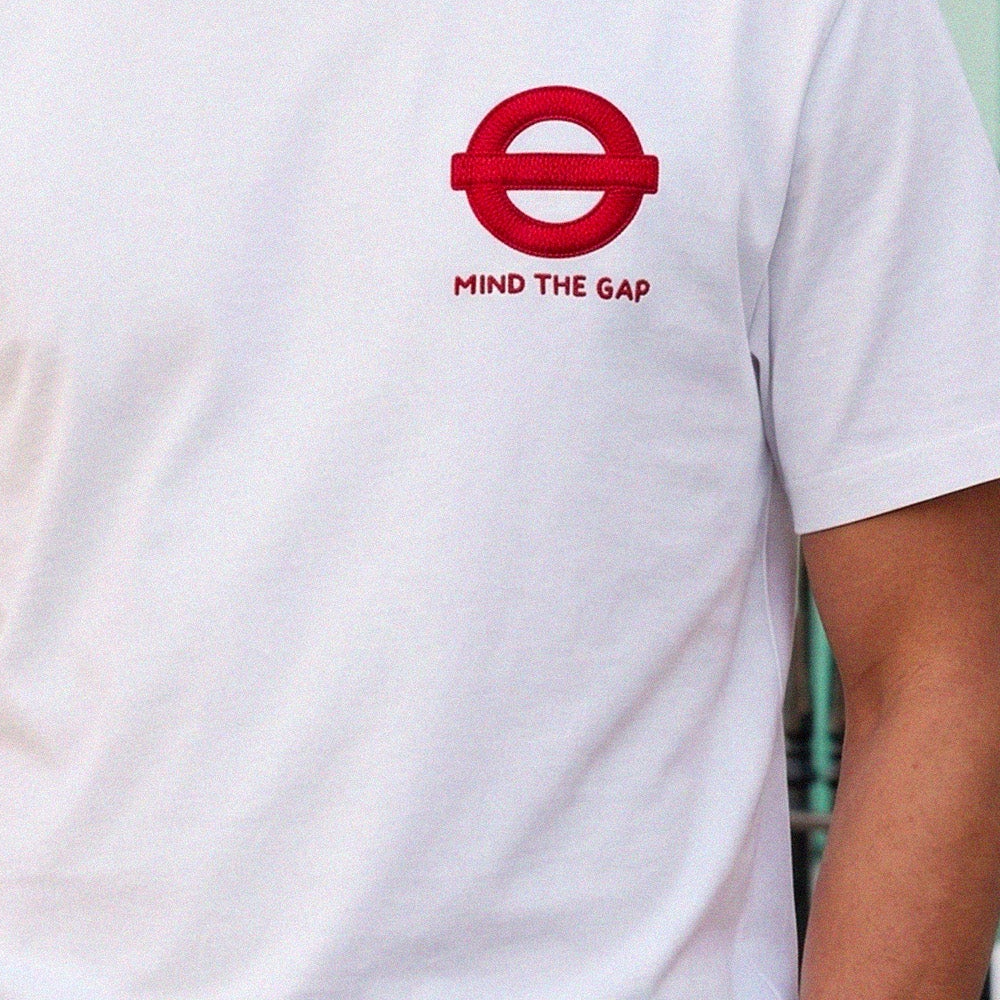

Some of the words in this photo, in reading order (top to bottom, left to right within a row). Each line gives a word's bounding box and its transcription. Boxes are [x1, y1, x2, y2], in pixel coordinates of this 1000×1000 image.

[454, 273, 526, 296] MIND
[534, 273, 587, 297] THE
[596, 276, 651, 303] GAP
